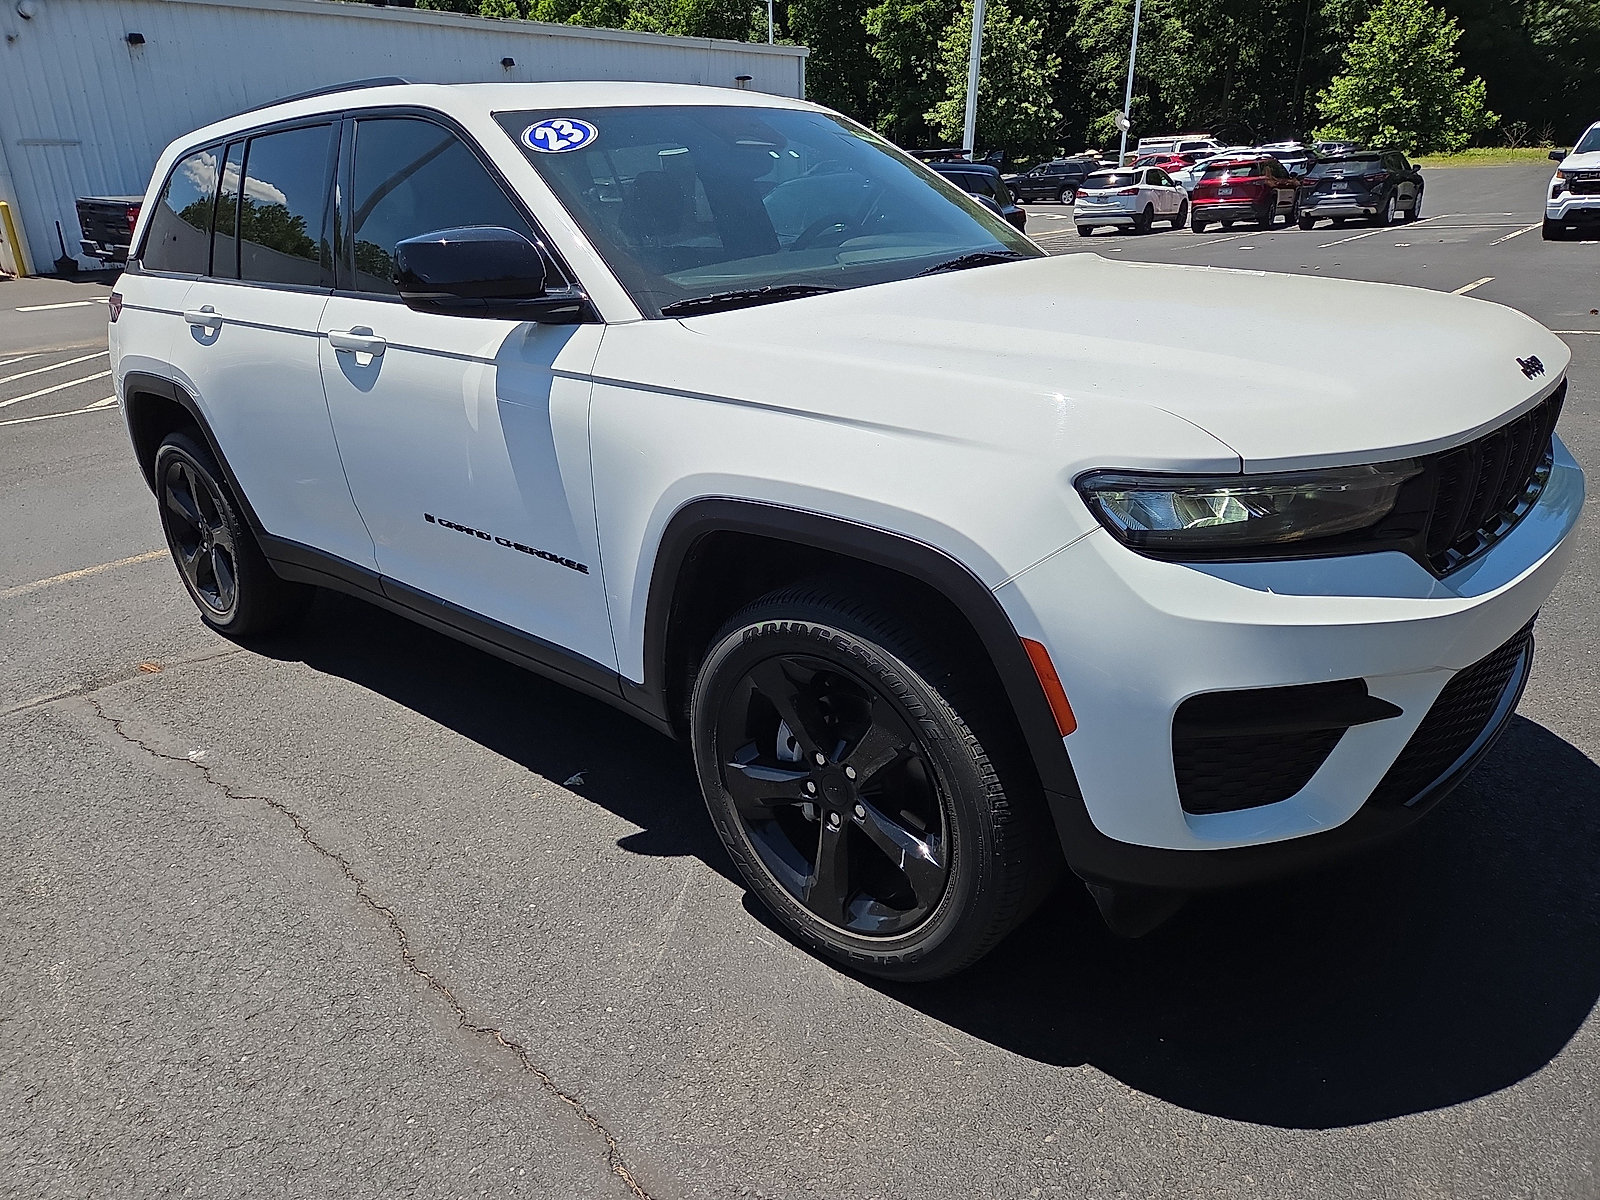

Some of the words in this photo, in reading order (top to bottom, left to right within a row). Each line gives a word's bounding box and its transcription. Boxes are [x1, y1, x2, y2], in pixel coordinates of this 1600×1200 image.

[534, 120, 584, 151] 23
[437, 518, 492, 541] GRAND
[494, 536, 590, 575] CHEROKEE
[742, 621, 946, 741] BRIDGESTONE
